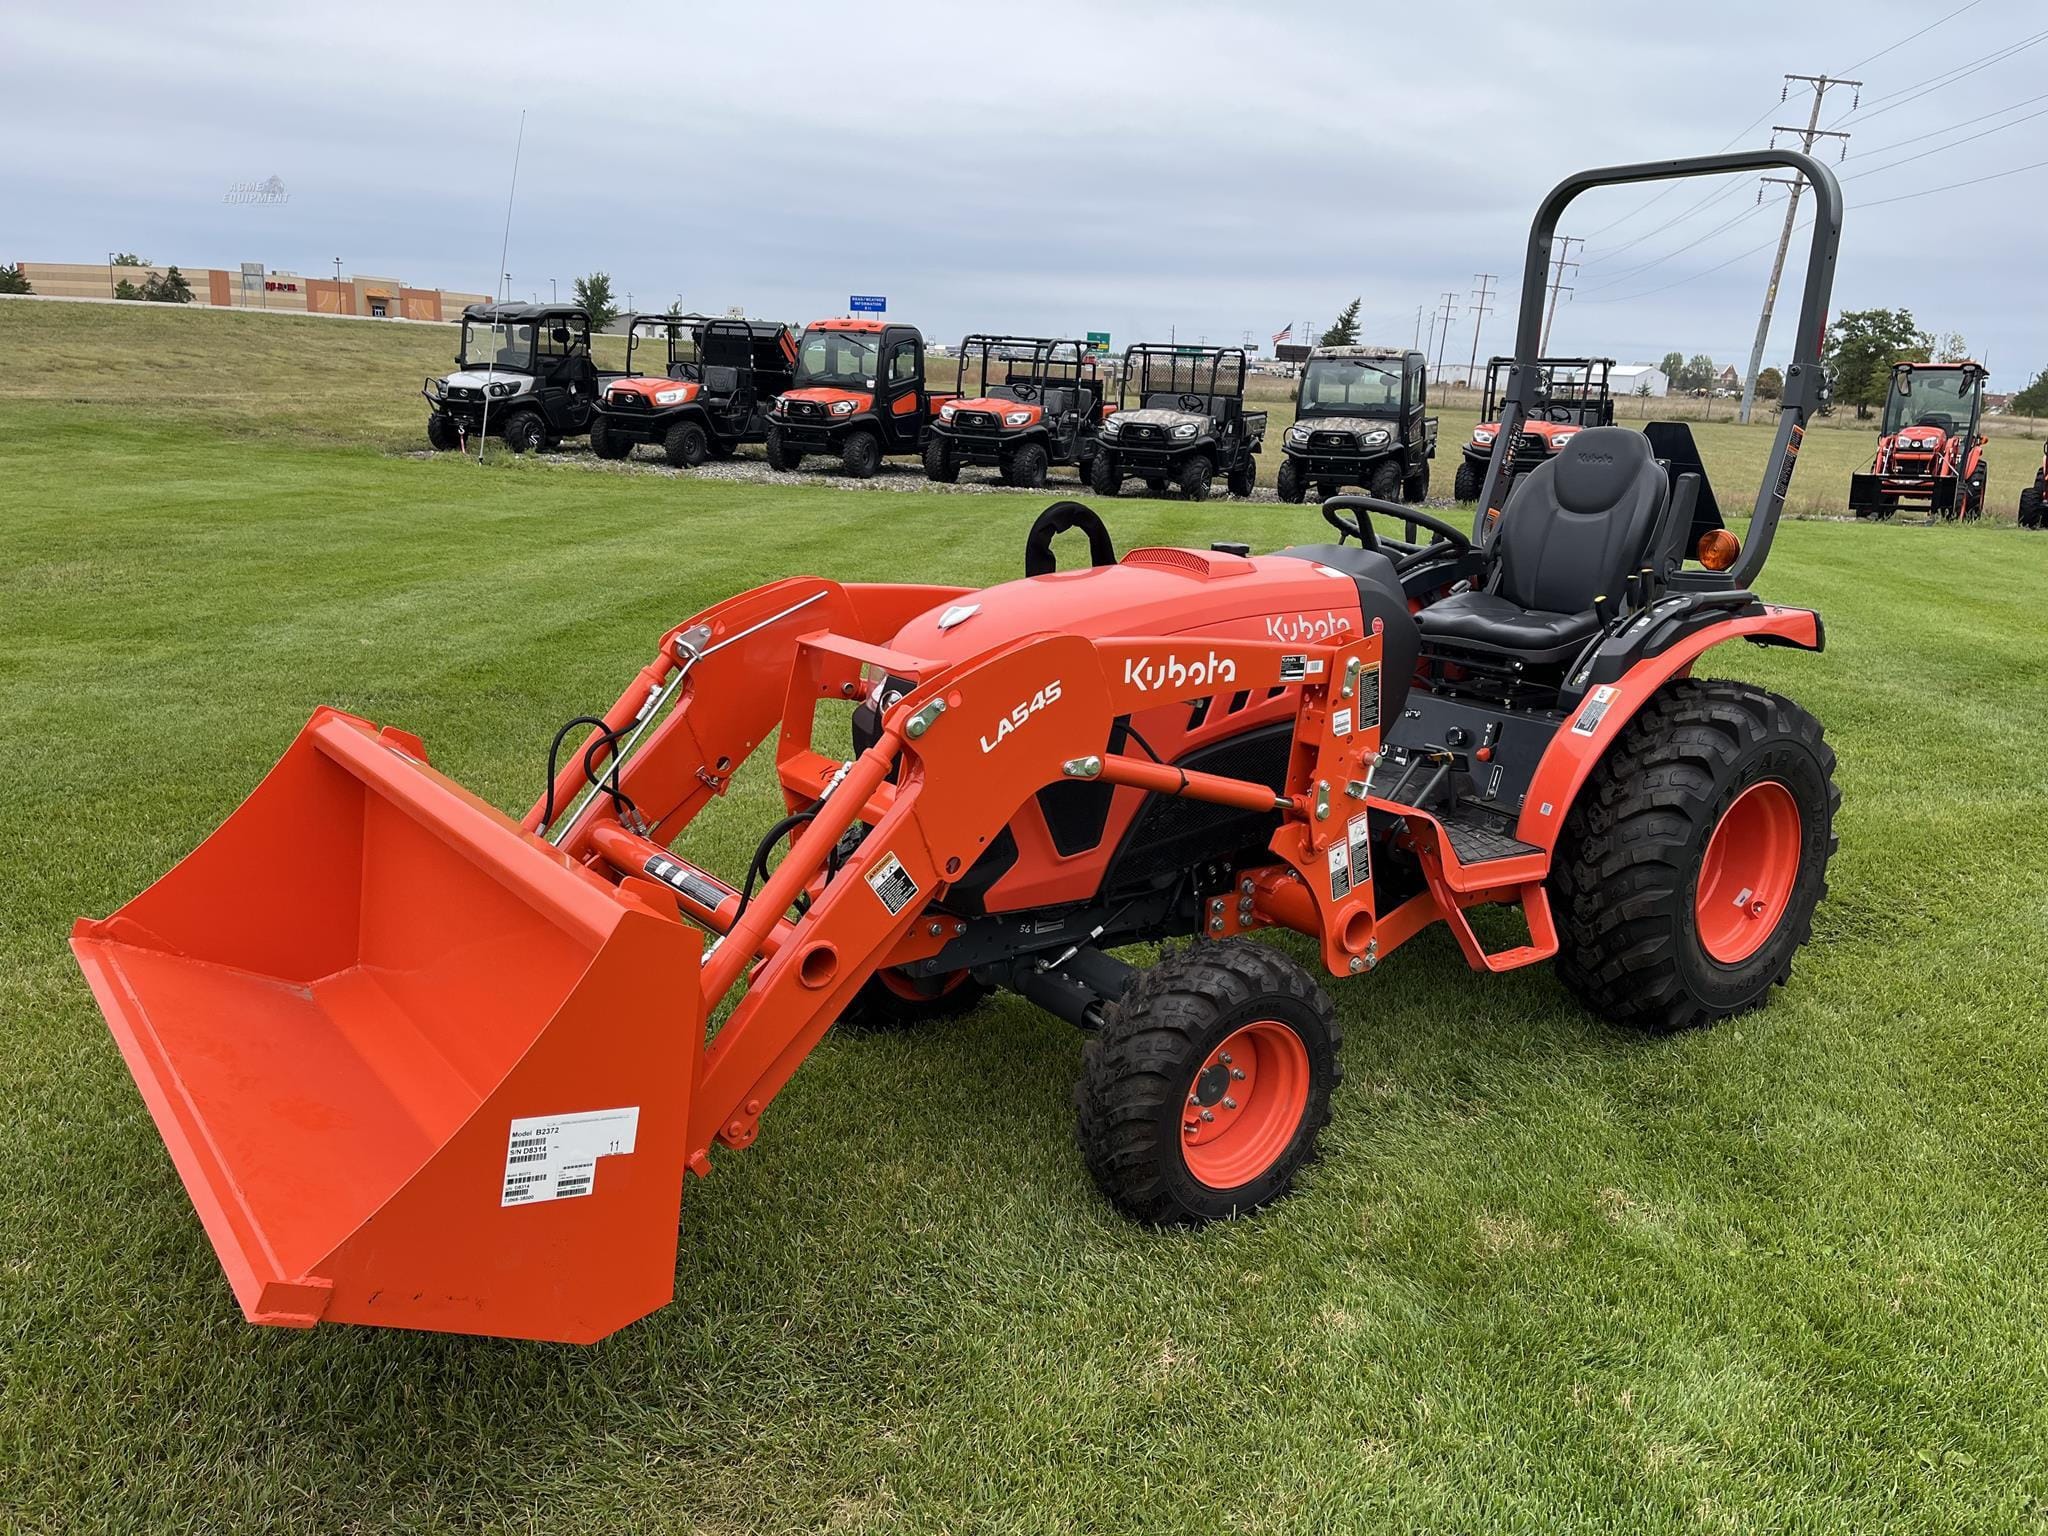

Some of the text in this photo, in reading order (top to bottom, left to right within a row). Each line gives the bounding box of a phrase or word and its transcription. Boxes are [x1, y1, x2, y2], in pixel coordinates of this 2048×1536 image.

[1266, 611, 1351, 642] Kubota
[1124, 650, 1236, 691] Kubota
[980, 679, 1062, 753] LA545
[536, 1127, 560, 1136] B2372
[523, 1146, 547, 1155] D8314
[609, 1141, 620, 1152] 11
